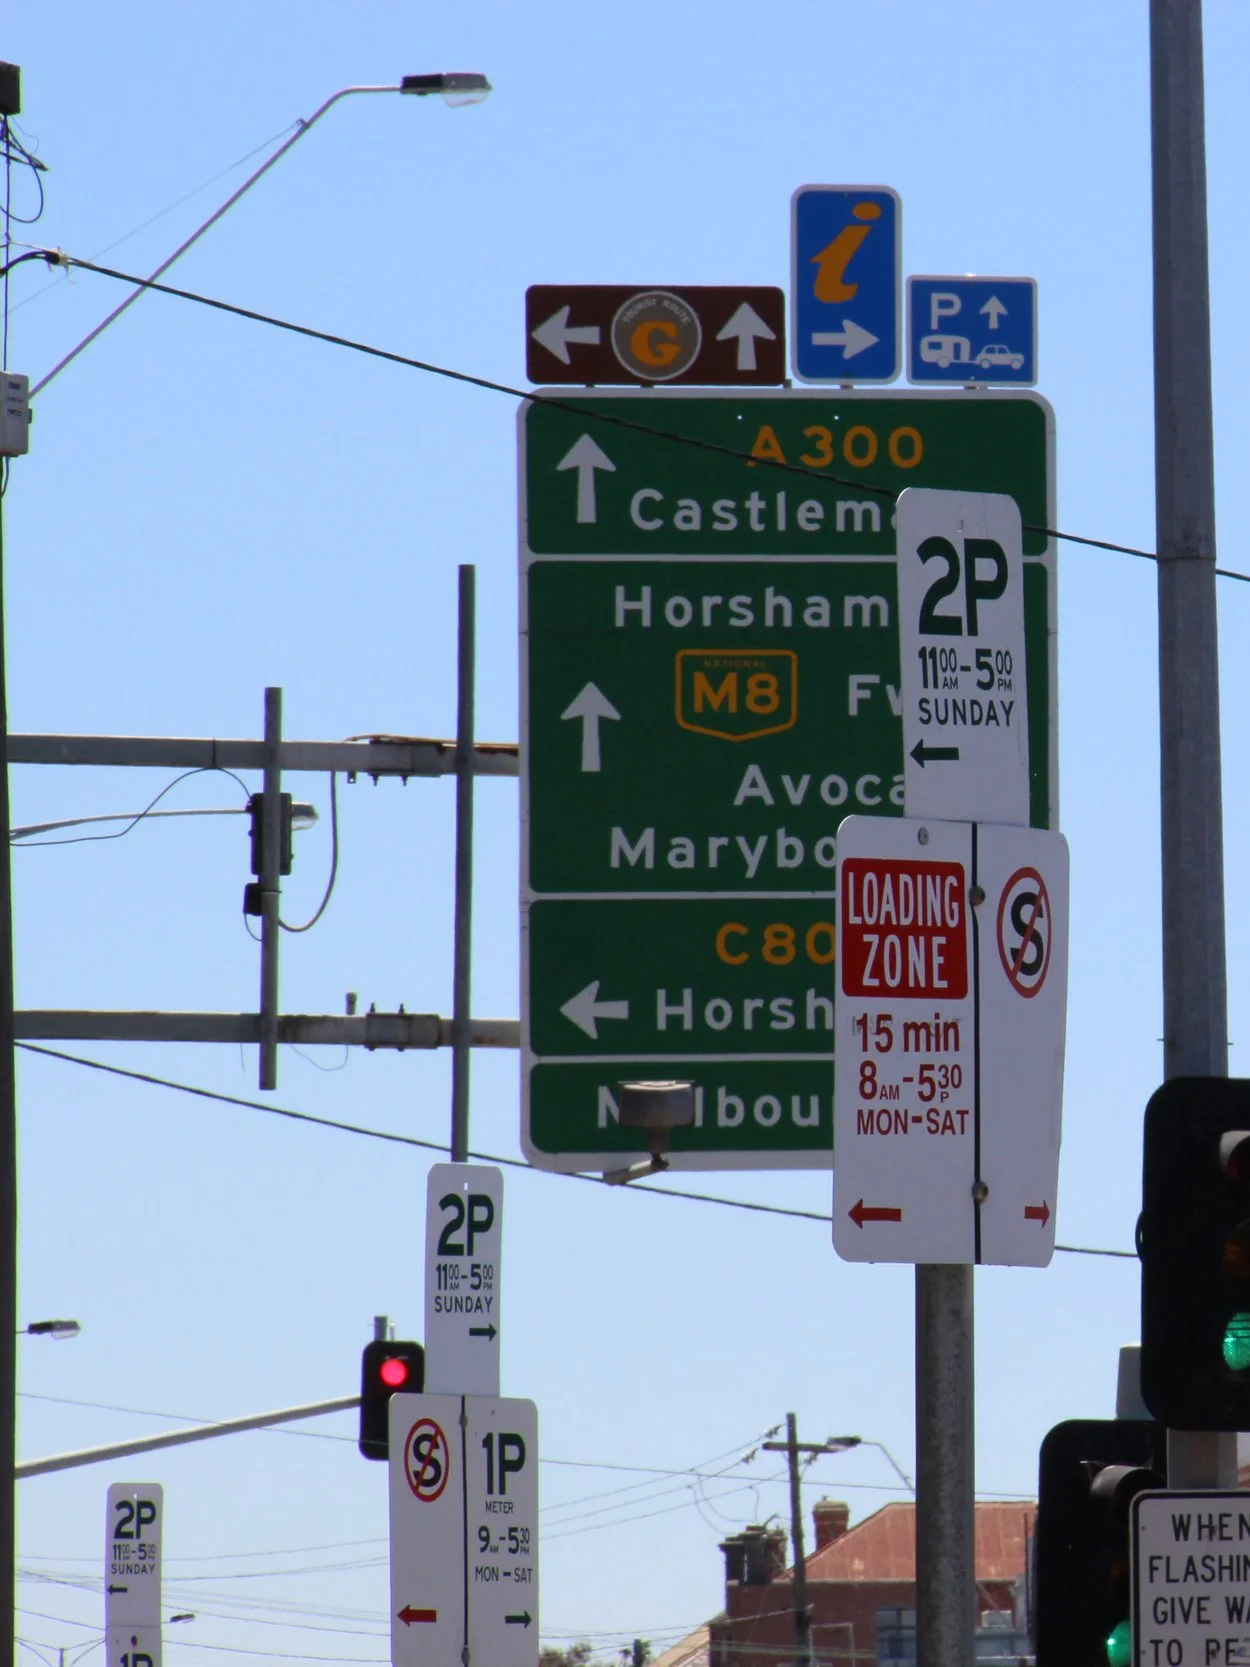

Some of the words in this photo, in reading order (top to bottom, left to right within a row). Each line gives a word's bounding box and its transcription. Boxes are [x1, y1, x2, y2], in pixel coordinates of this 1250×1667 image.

[930, 293, 962, 329] P
[631, 321, 682, 366] G
[630, 489, 896, 532] Castlem
[916, 536, 1008, 636] 2P
[615, 586, 888, 627] Horsham
[703, 659, 769, 669] NATIONAL
[693, 672, 779, 714] M8
[919, 698, 1014, 727] SUNDAY
[848, 872, 958, 929] LOADING
[862, 934, 948, 988] ZONE
[856, 1013, 892, 1053] 15
[903, 1013, 960, 1052] min
[437, 1193, 494, 1256] 2P
[435, 1296, 493, 1313] SUNDAY
[482, 1433, 525, 1495] 1P
[114, 1500, 156, 1539] 2P
[485, 1501, 514, 1514] METER
[111, 1564, 155, 1574] SUNDAY
[1153, 1596, 1211, 1625] GIVE
[1149, 1639, 1183, 1666] TO
